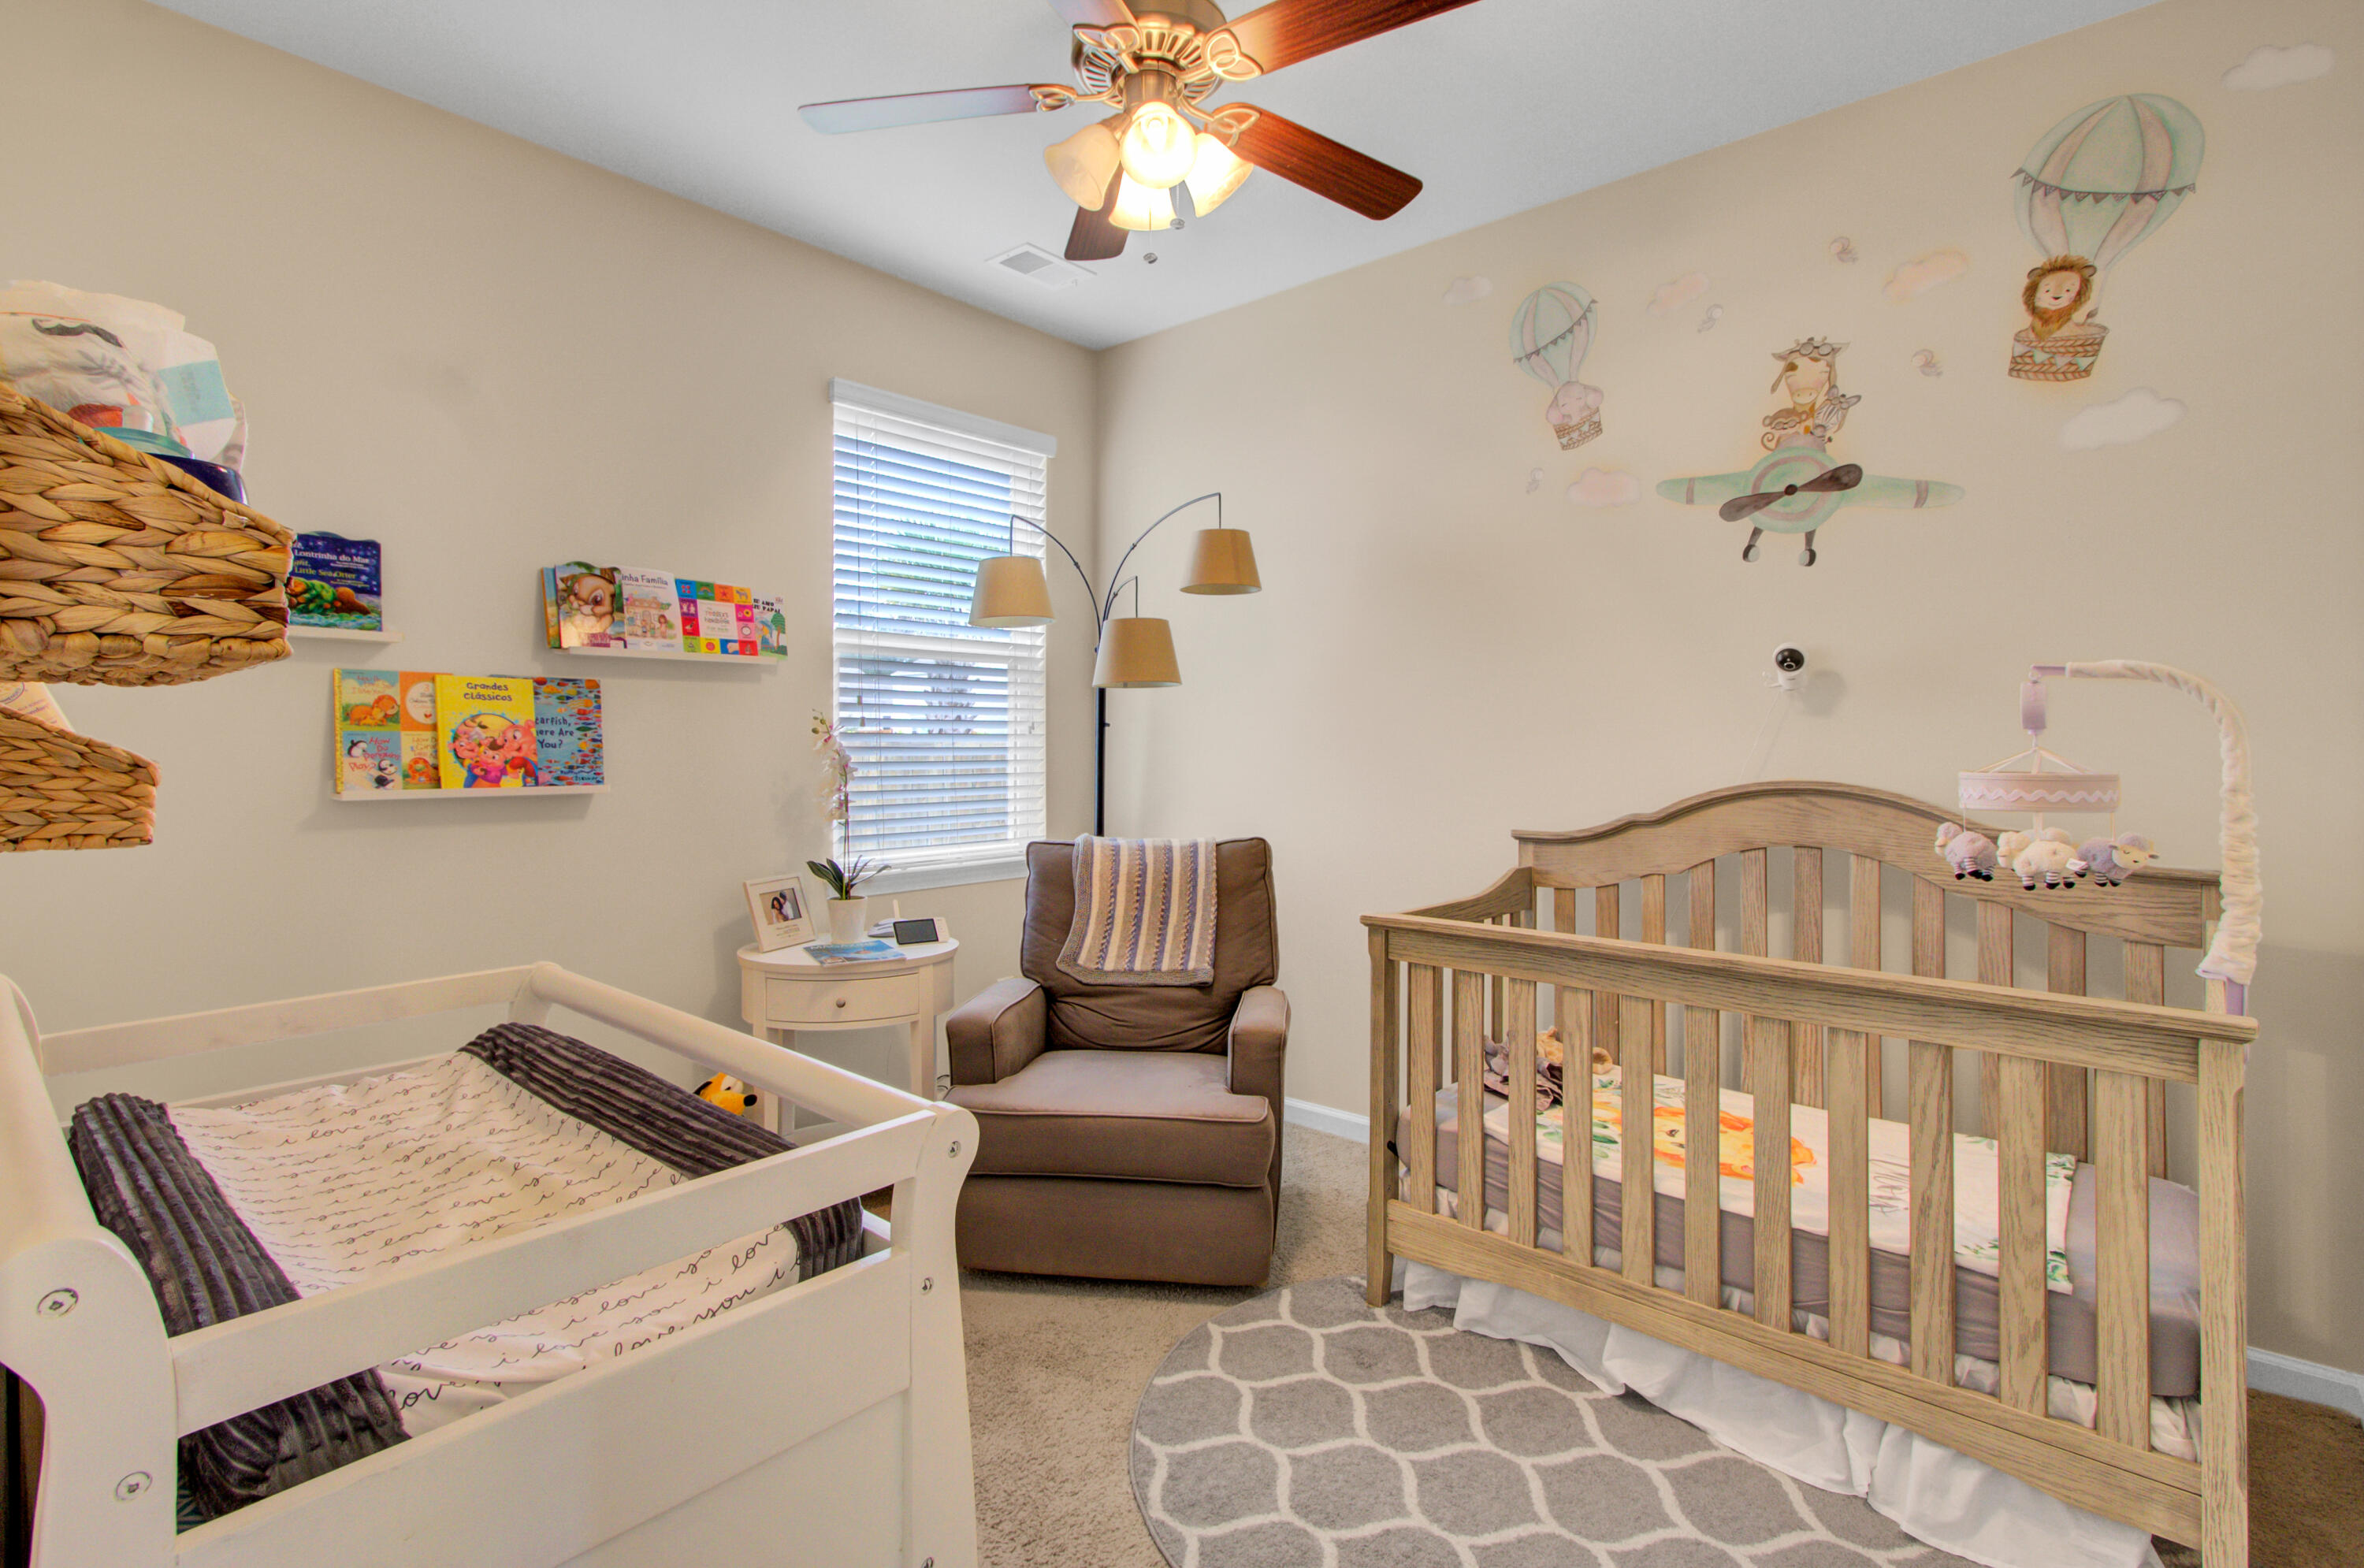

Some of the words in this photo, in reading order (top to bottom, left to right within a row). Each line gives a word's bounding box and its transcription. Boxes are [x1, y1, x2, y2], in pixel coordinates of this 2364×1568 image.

[622, 574, 639, 583] inha
[466, 682, 509, 691] Grandes
[463, 692, 512, 701] Clássicos
[535, 716, 572, 726] tarfish,
[559, 727, 574, 737] Are
[537, 738, 563, 749] You?
[305, 1124, 366, 1141] love
[731, 1222, 788, 1275] love
[598, 1282, 667, 1316] love
